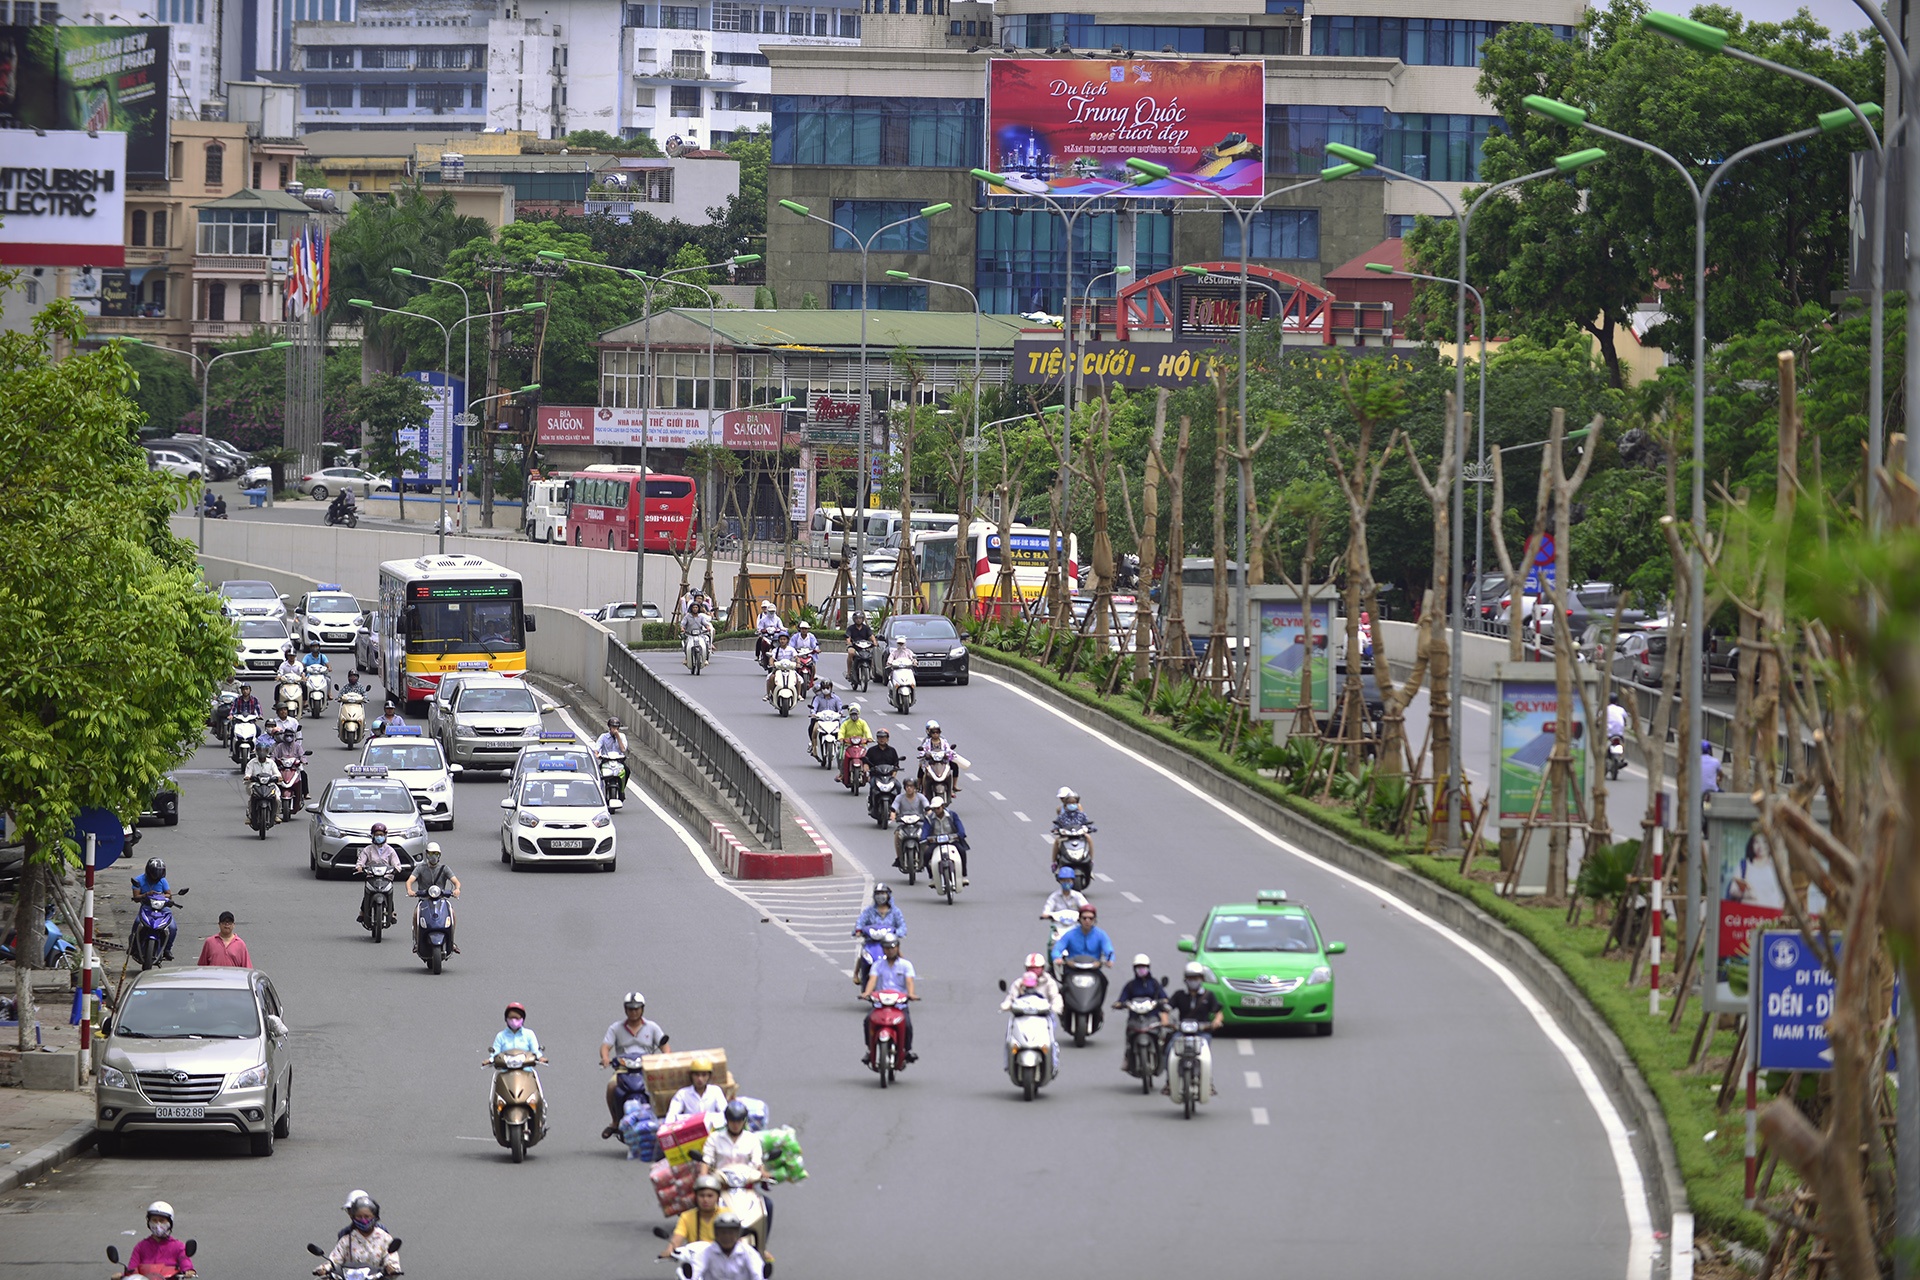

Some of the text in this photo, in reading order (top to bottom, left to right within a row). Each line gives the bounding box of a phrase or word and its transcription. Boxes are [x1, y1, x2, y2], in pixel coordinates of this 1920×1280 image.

[1050, 79, 1109, 99] Du lịch
[1067, 95, 1187, 132] Trung Quốc
[1088, 132, 1116, 141] 2016
[1157, 122, 1189, 147] đẹp
[1187, 295, 1239, 326] LONG
[1028, 347, 1077, 379] TIỆC
[1083, 348, 1136, 376] CƯỚI
[559, 410, 571, 418] BIA
[747, 415, 759, 423] BIA
[547, 418, 584, 430] SAIGON
[686, 419, 699, 428] BIA
[734, 422, 771, 435] SAIGON
[1033, 550, 1048, 559] HÀ
[1272, 618, 1322, 629] OLYMIC
[1795, 969, 1810, 986] DI
[1773, 1024, 1804, 1040] NAM
